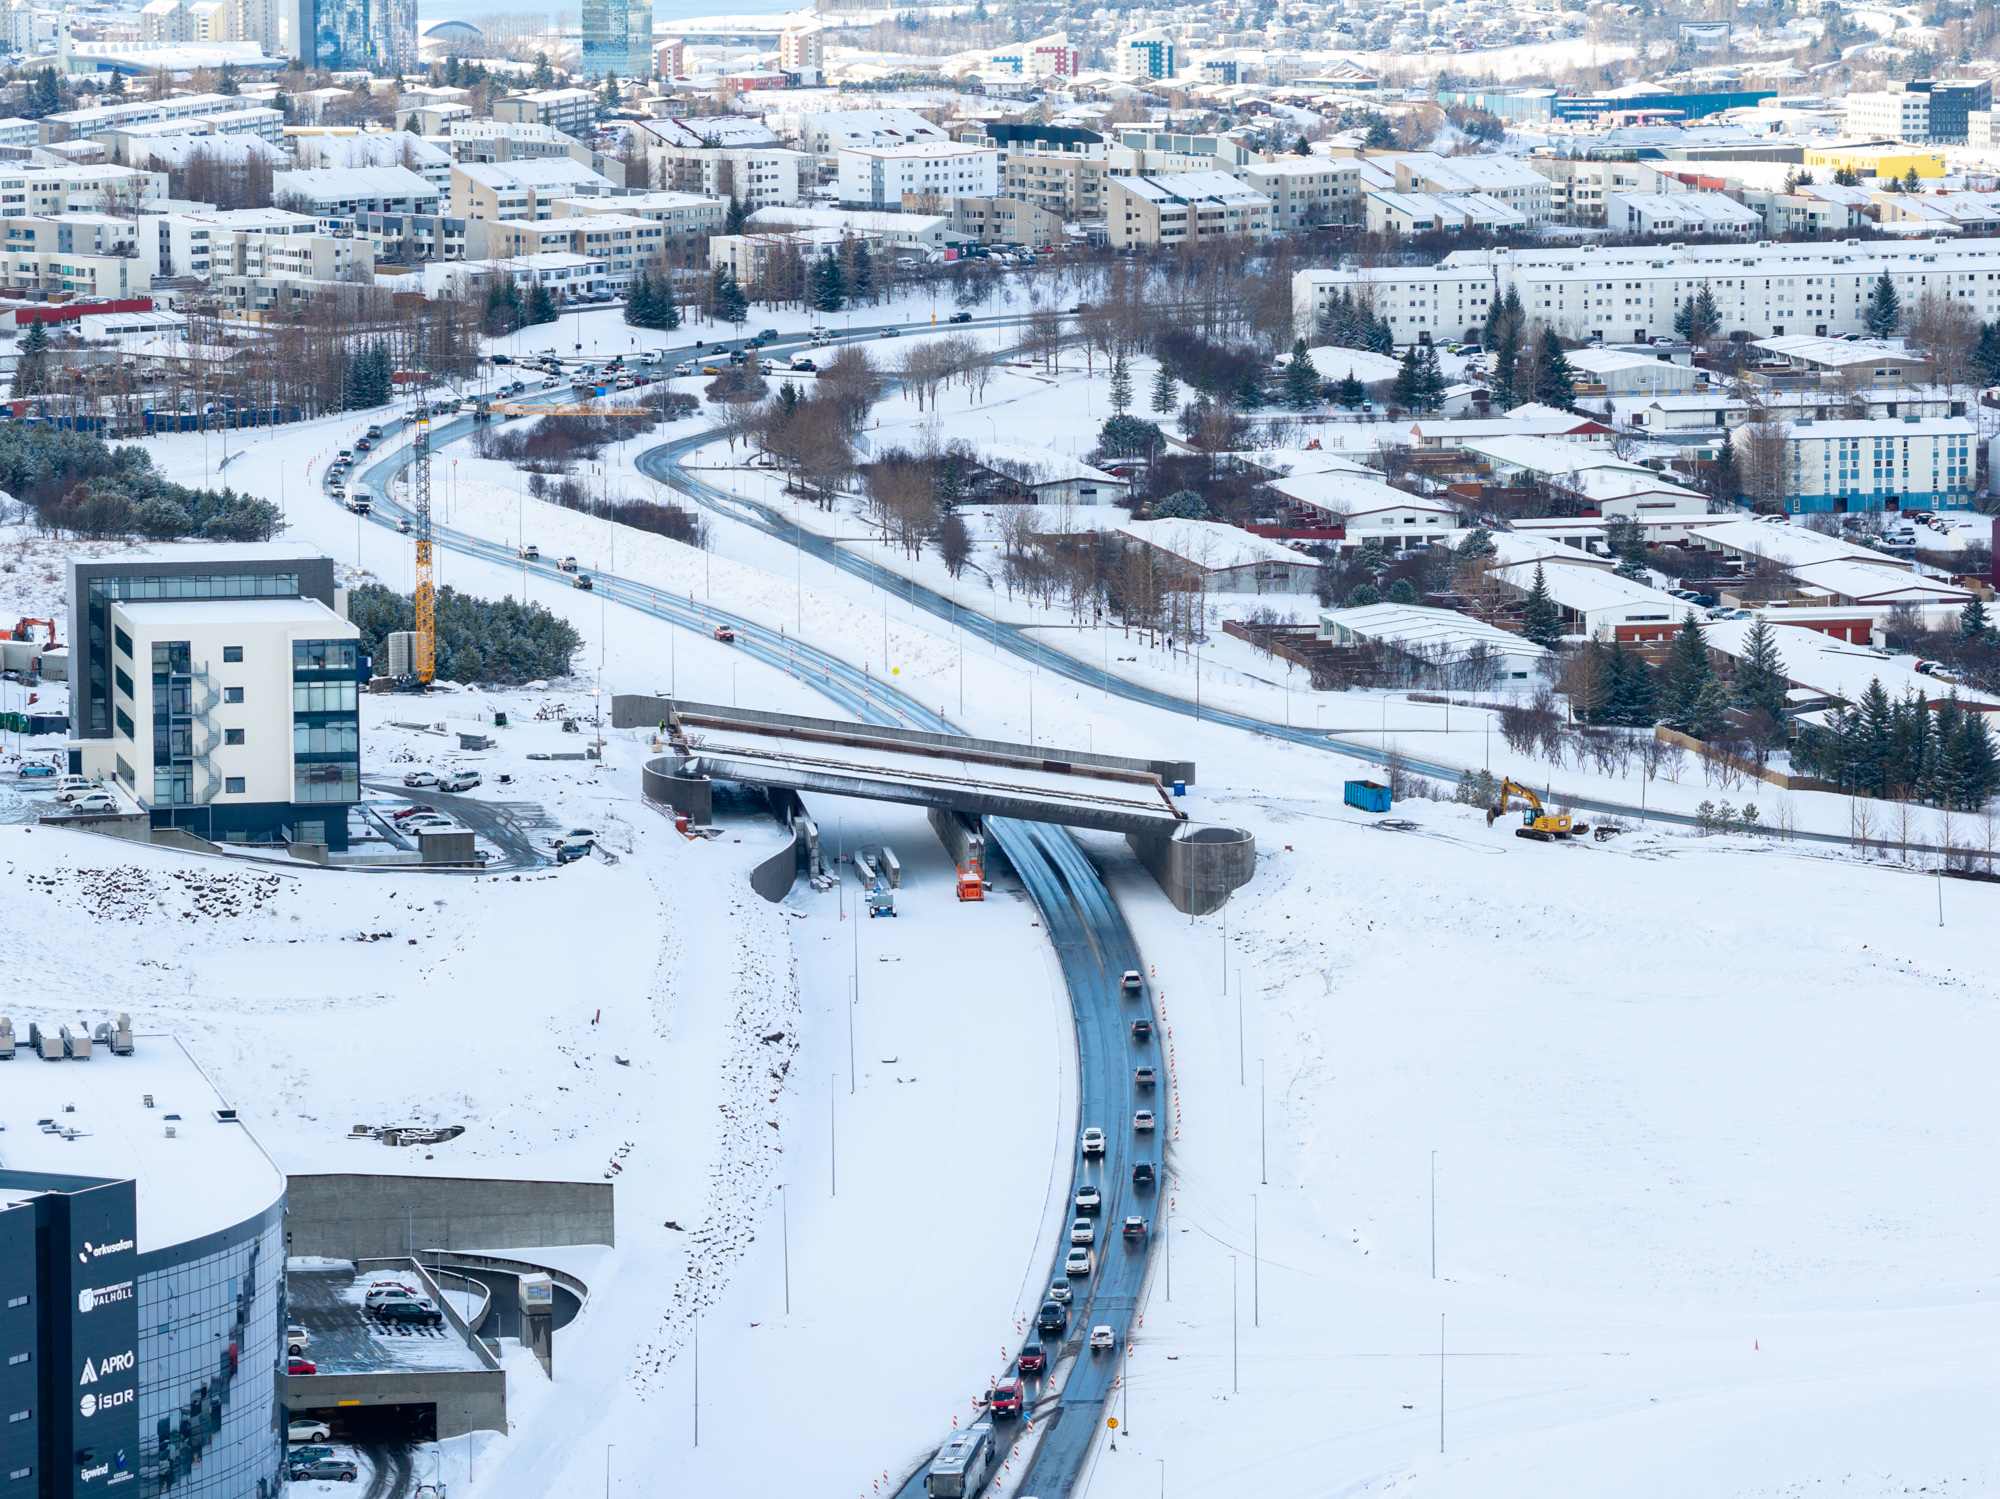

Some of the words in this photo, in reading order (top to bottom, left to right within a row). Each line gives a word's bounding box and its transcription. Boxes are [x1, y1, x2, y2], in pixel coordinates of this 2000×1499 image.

[93, 1239, 133, 1257] orkusalan
[100, 1350, 134, 1375] APRÓ
[98, 1389, 133, 1410] ÍSOR
